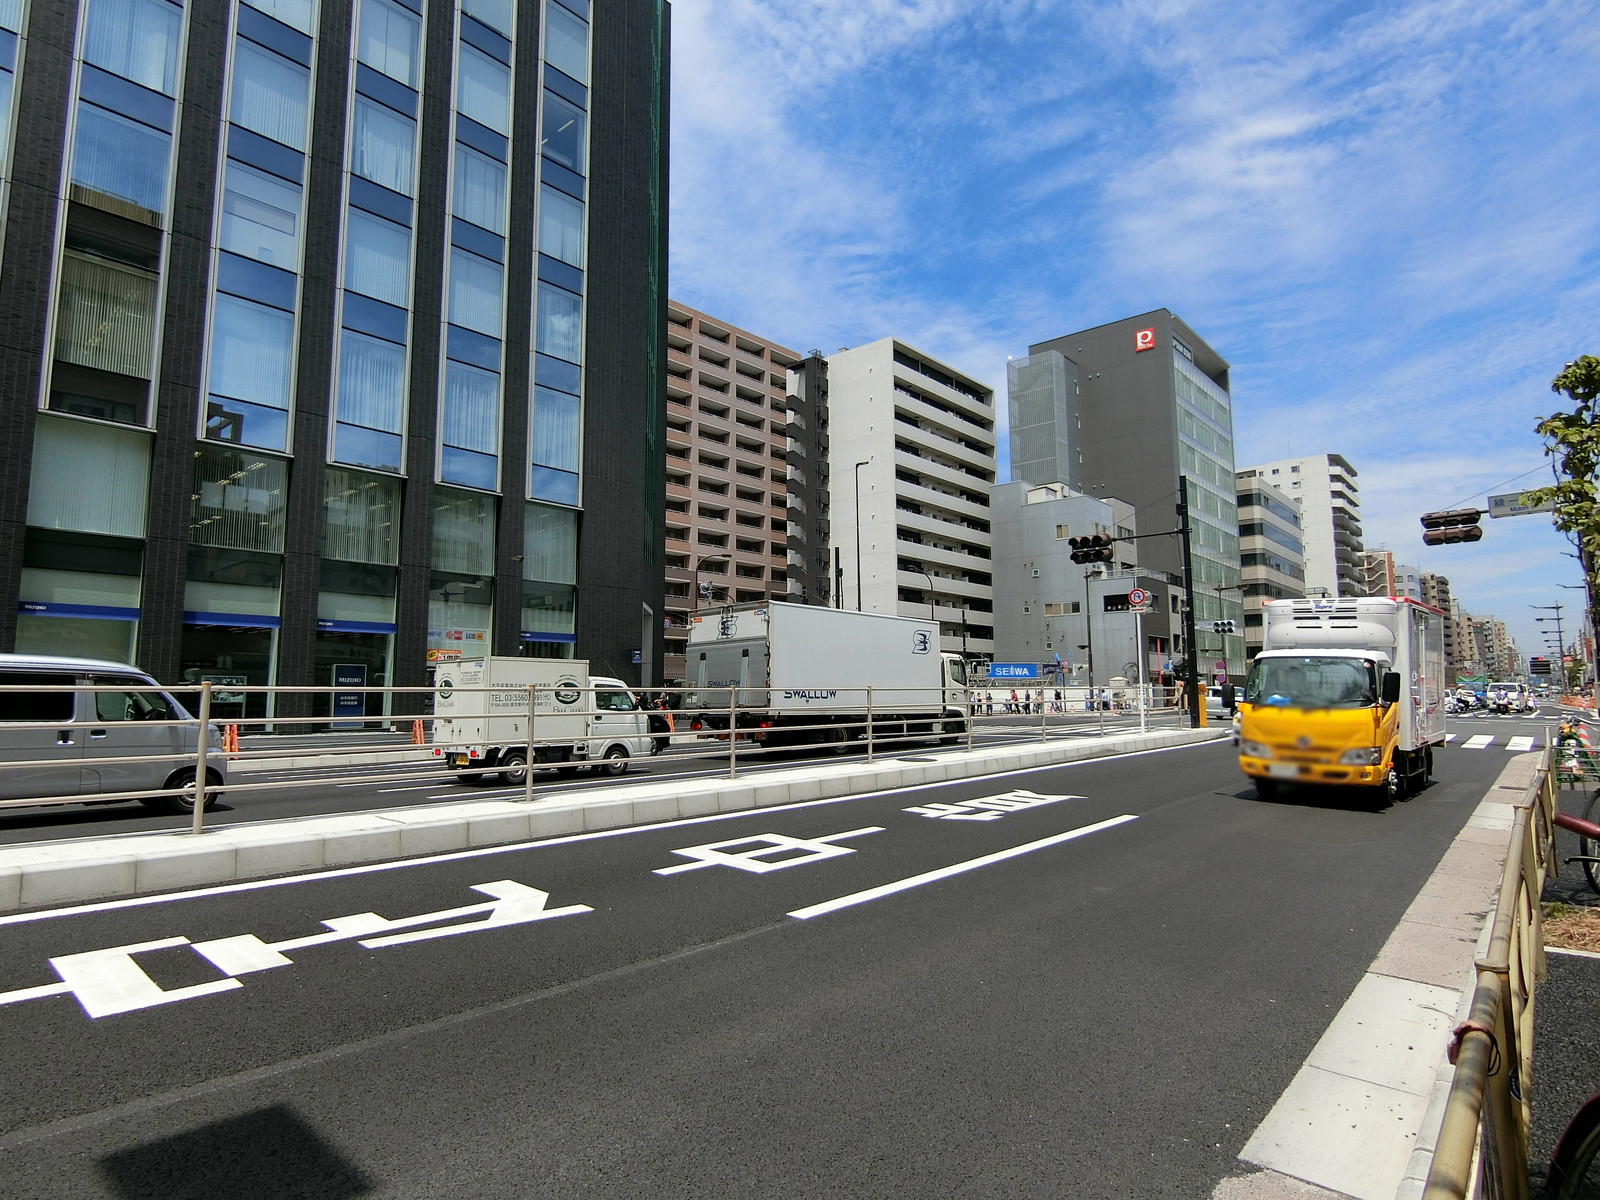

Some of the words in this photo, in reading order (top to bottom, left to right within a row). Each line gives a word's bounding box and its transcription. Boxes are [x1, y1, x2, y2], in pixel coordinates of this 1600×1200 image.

[995, 664, 1029, 676] SEIWA
[707, 679, 740, 687] SWALLOW
[784, 690, 837, 699] SWALLOW
